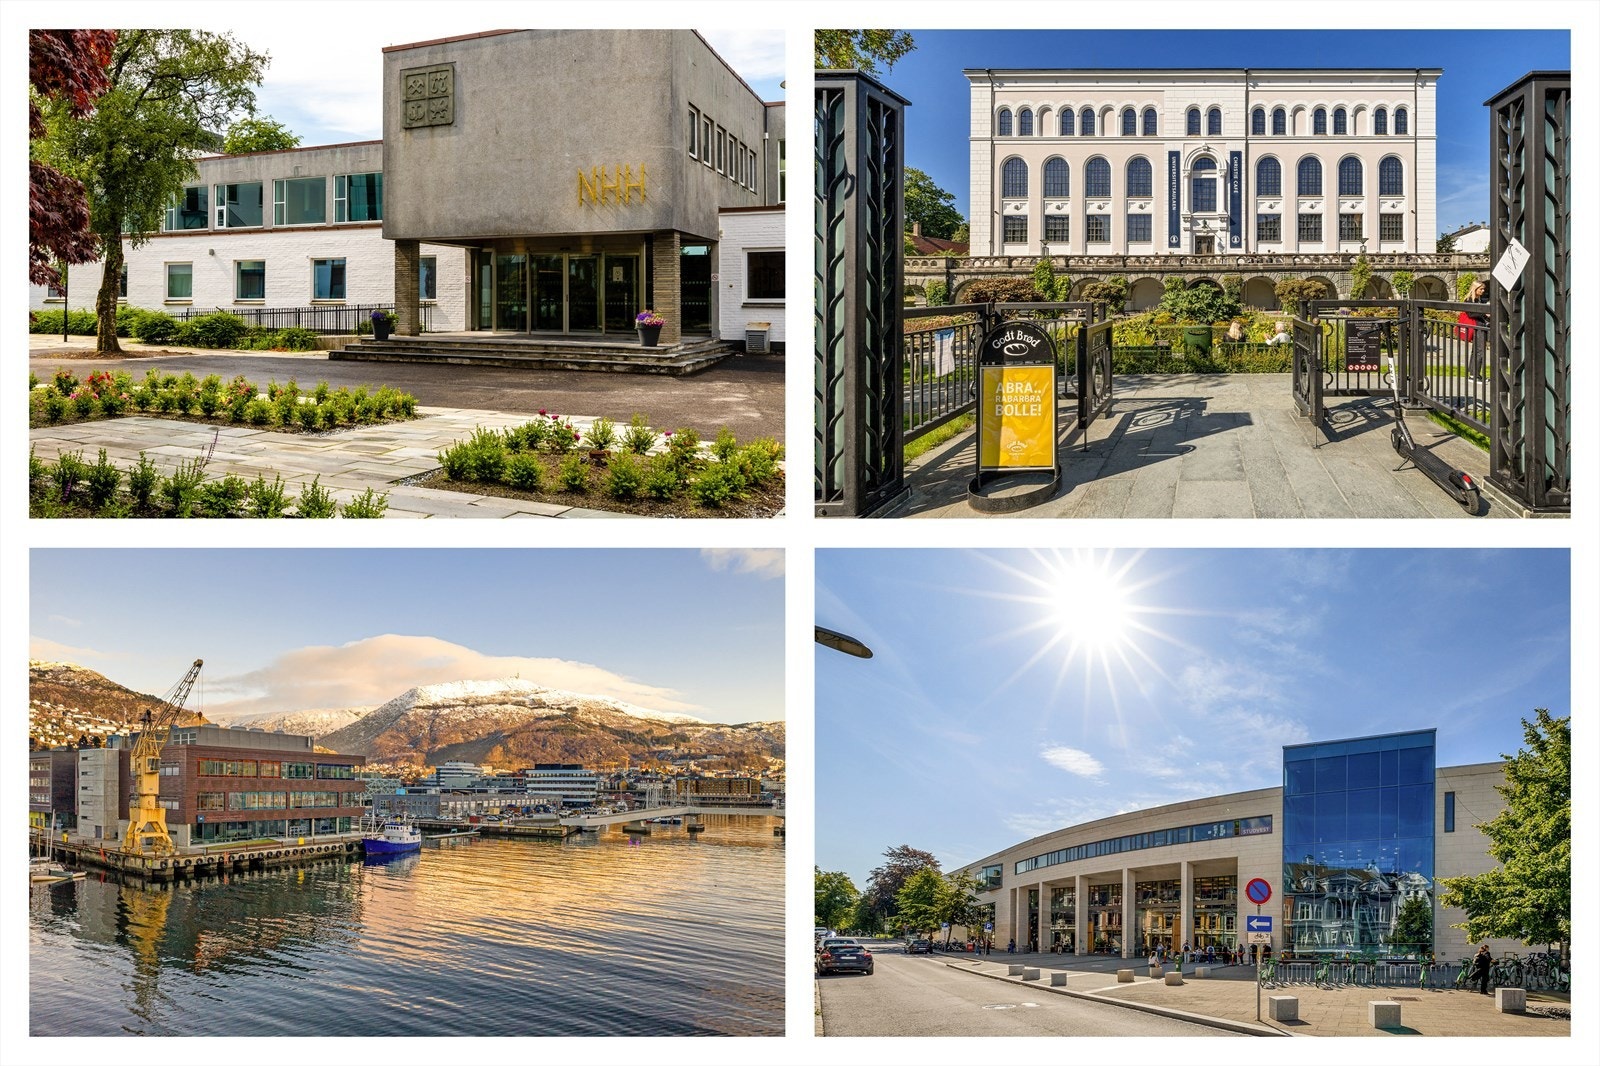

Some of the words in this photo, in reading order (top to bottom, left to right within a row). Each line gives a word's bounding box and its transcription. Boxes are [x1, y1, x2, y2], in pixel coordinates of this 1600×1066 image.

[578, 162, 645, 208] NHH
[992, 330, 1014, 349] Godt
[1016, 330, 1041, 348] Brød
[995, 382, 1042, 394] ABRA..
[995, 395, 1042, 403] RABARBRA
[995, 404, 1042, 417] BOLLE!
